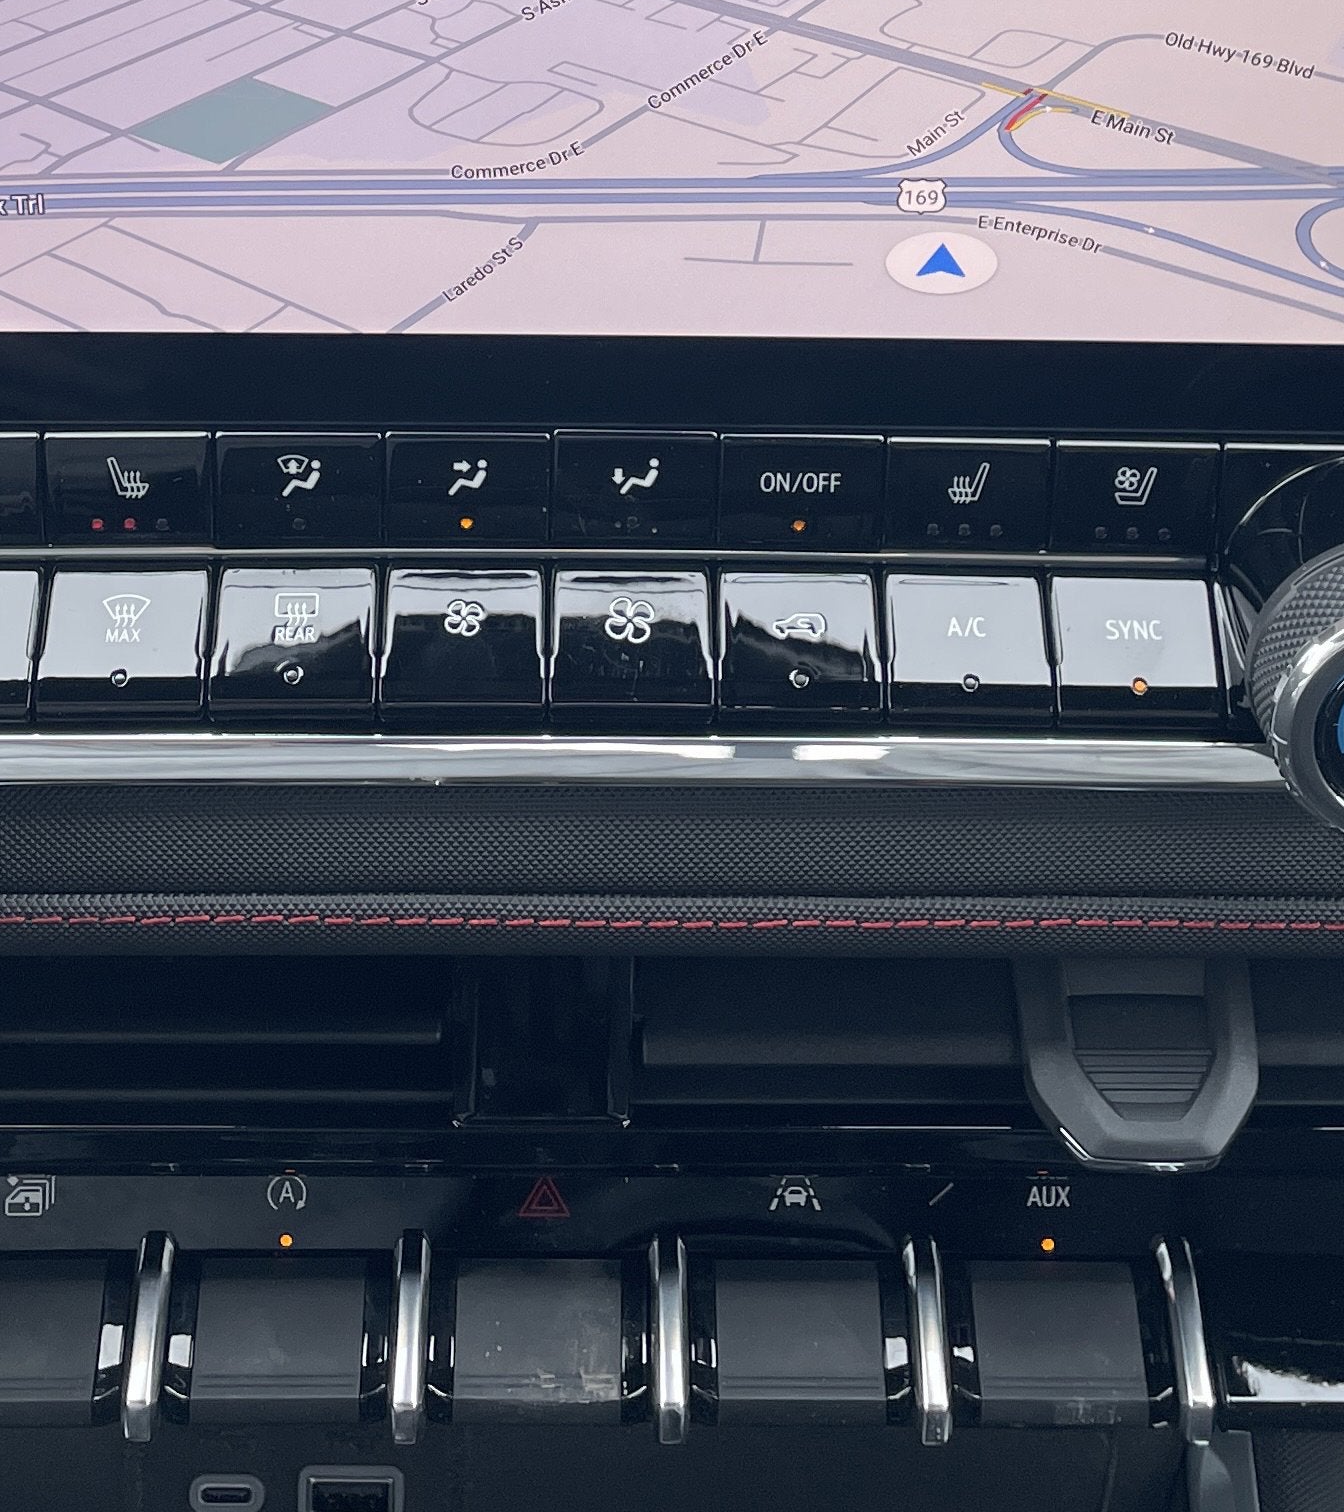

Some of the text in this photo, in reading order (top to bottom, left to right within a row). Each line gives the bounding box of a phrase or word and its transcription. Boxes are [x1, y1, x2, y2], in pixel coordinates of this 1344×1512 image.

[521, 6, 534, 21] S
[1165, 32, 1315, 80] Old Hwy 169 Blvd
[647, 30, 768, 109] Commerce Dr E
[906, 111, 965, 157] Main St
[1091, 110, 1175, 145] E Main St
[451, 141, 585, 179] Commerce Dr E
[11, 193, 45, 216] Trl
[904, 190, 939, 206] 169
[978, 216, 1103, 254] E Enterprise Dr
[442, 237, 523, 302] Laredo St S
[760, 471, 843, 495] ON/OFF
[105, 628, 141, 643] MAX
[274, 626, 315, 643] REAR
[947, 617, 986, 639] A/C
[1105, 619, 1163, 641] SYNC
[1026, 1185, 1071, 1208] AUX
